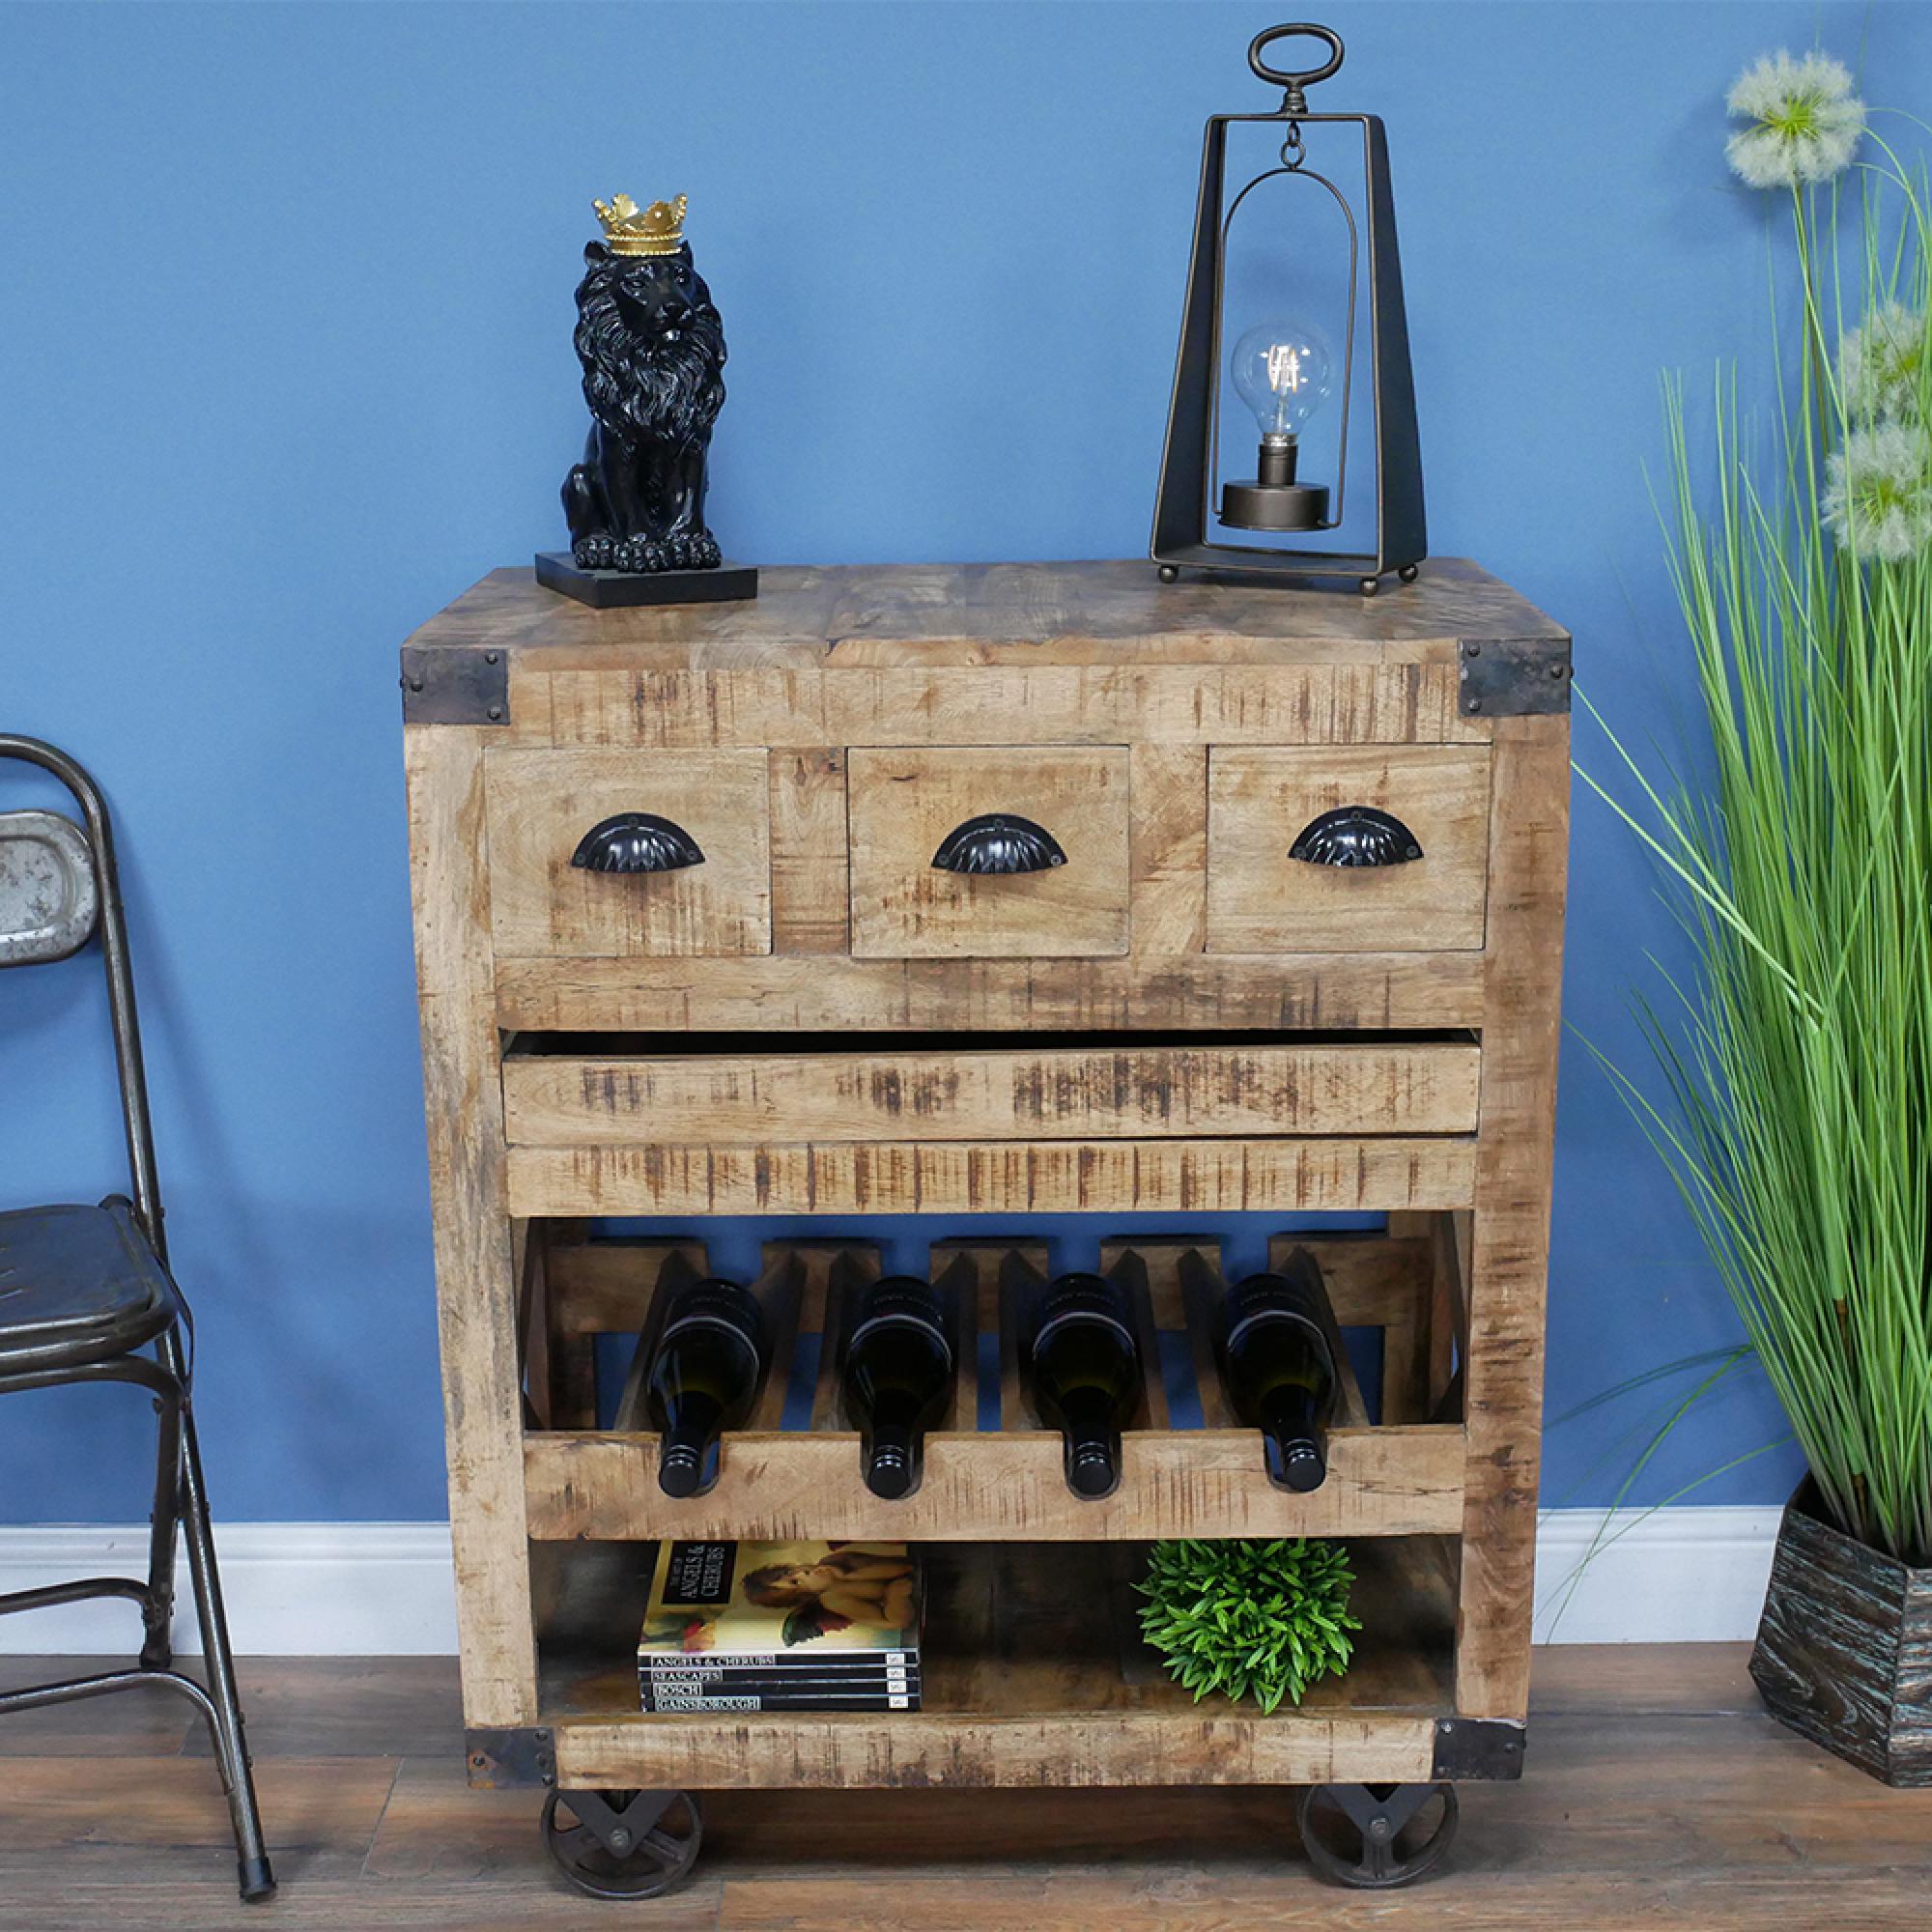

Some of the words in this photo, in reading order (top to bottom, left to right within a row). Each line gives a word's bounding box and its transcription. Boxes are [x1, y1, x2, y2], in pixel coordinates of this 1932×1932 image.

[687, 1545, 705, 1554] &
[701, 1547, 725, 1597] CHERUBS
[680, 1557, 704, 1599] ANGELS
[653, 1656, 702, 1666] ANGELS
[654, 1671, 720, 1681] SEASCAPES
[657, 1685, 699, 1695] BOSCH
[658, 1698, 758, 1710] GAINSBOROUGH
